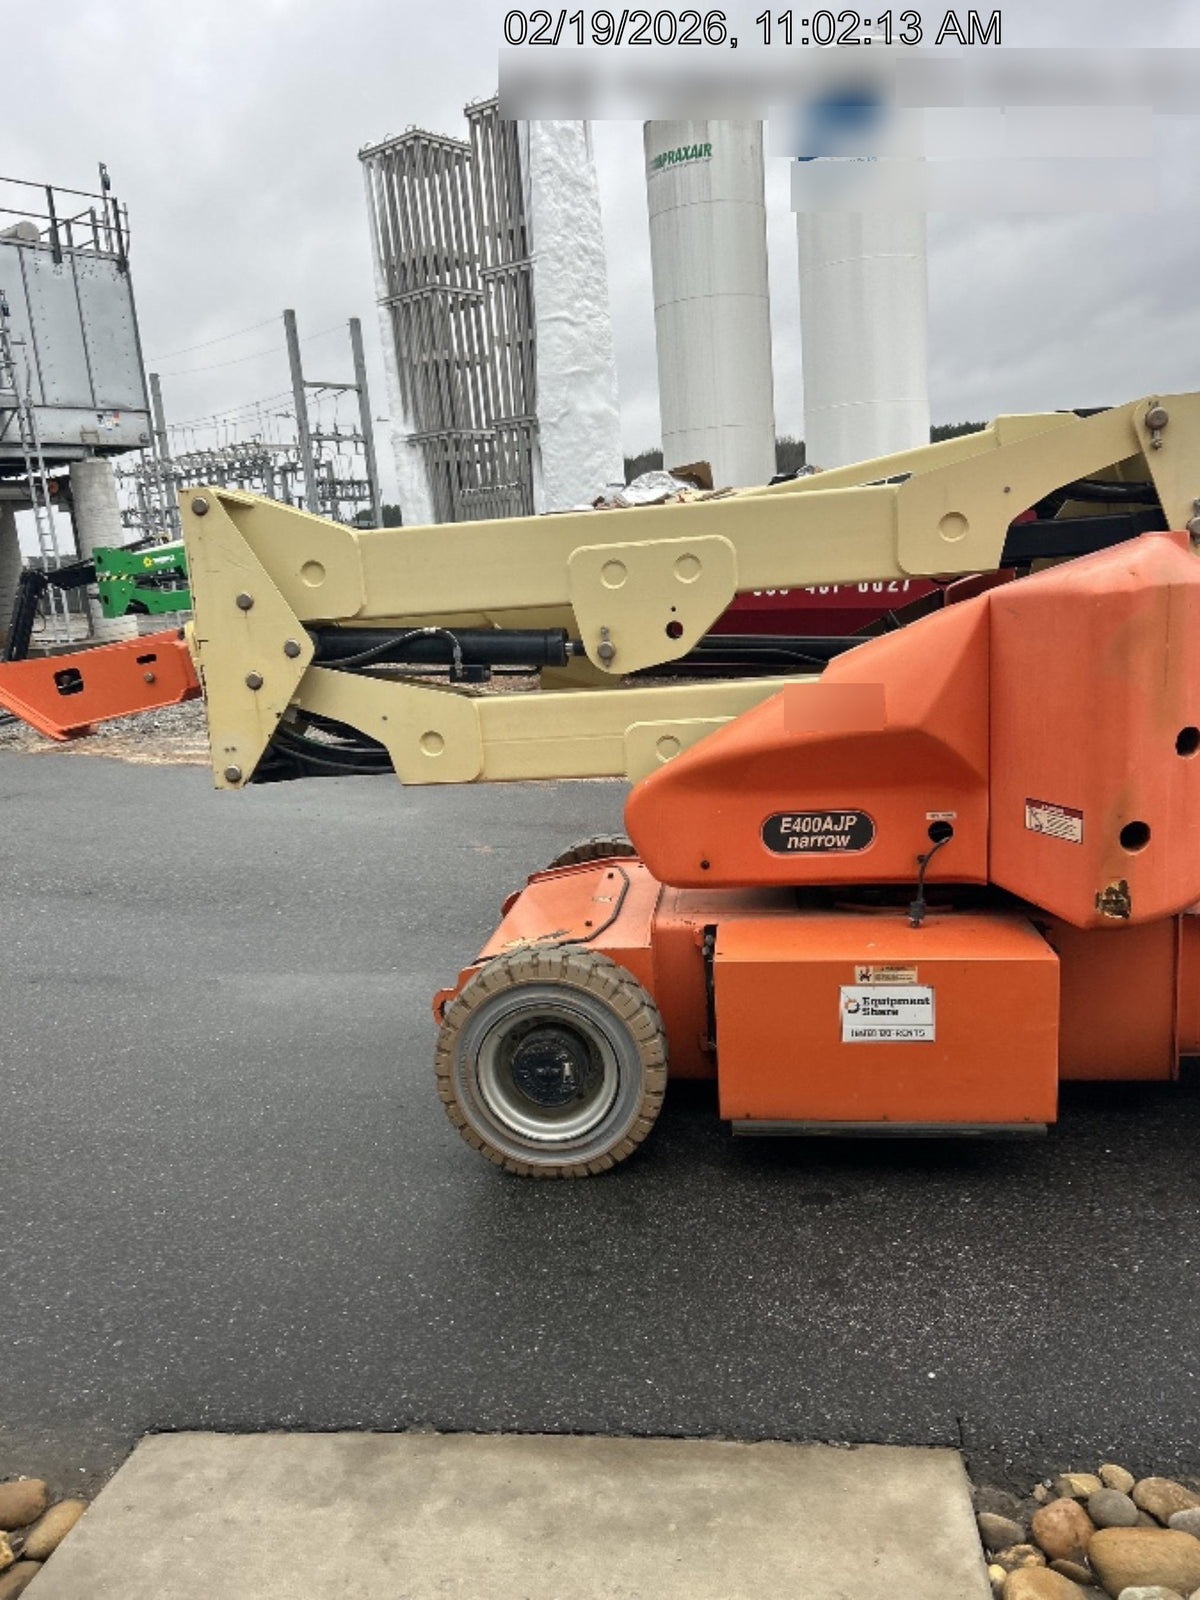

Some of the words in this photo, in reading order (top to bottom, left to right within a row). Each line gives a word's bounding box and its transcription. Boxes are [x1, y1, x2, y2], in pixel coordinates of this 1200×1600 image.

[655, 142, 712, 168] PRAXAIR
[780, 815, 858, 834] E400AJP
[787, 834, 851, 849] narrow
[862, 997, 931, 1008] Equipment
[862, 1007, 899, 1016] Share
